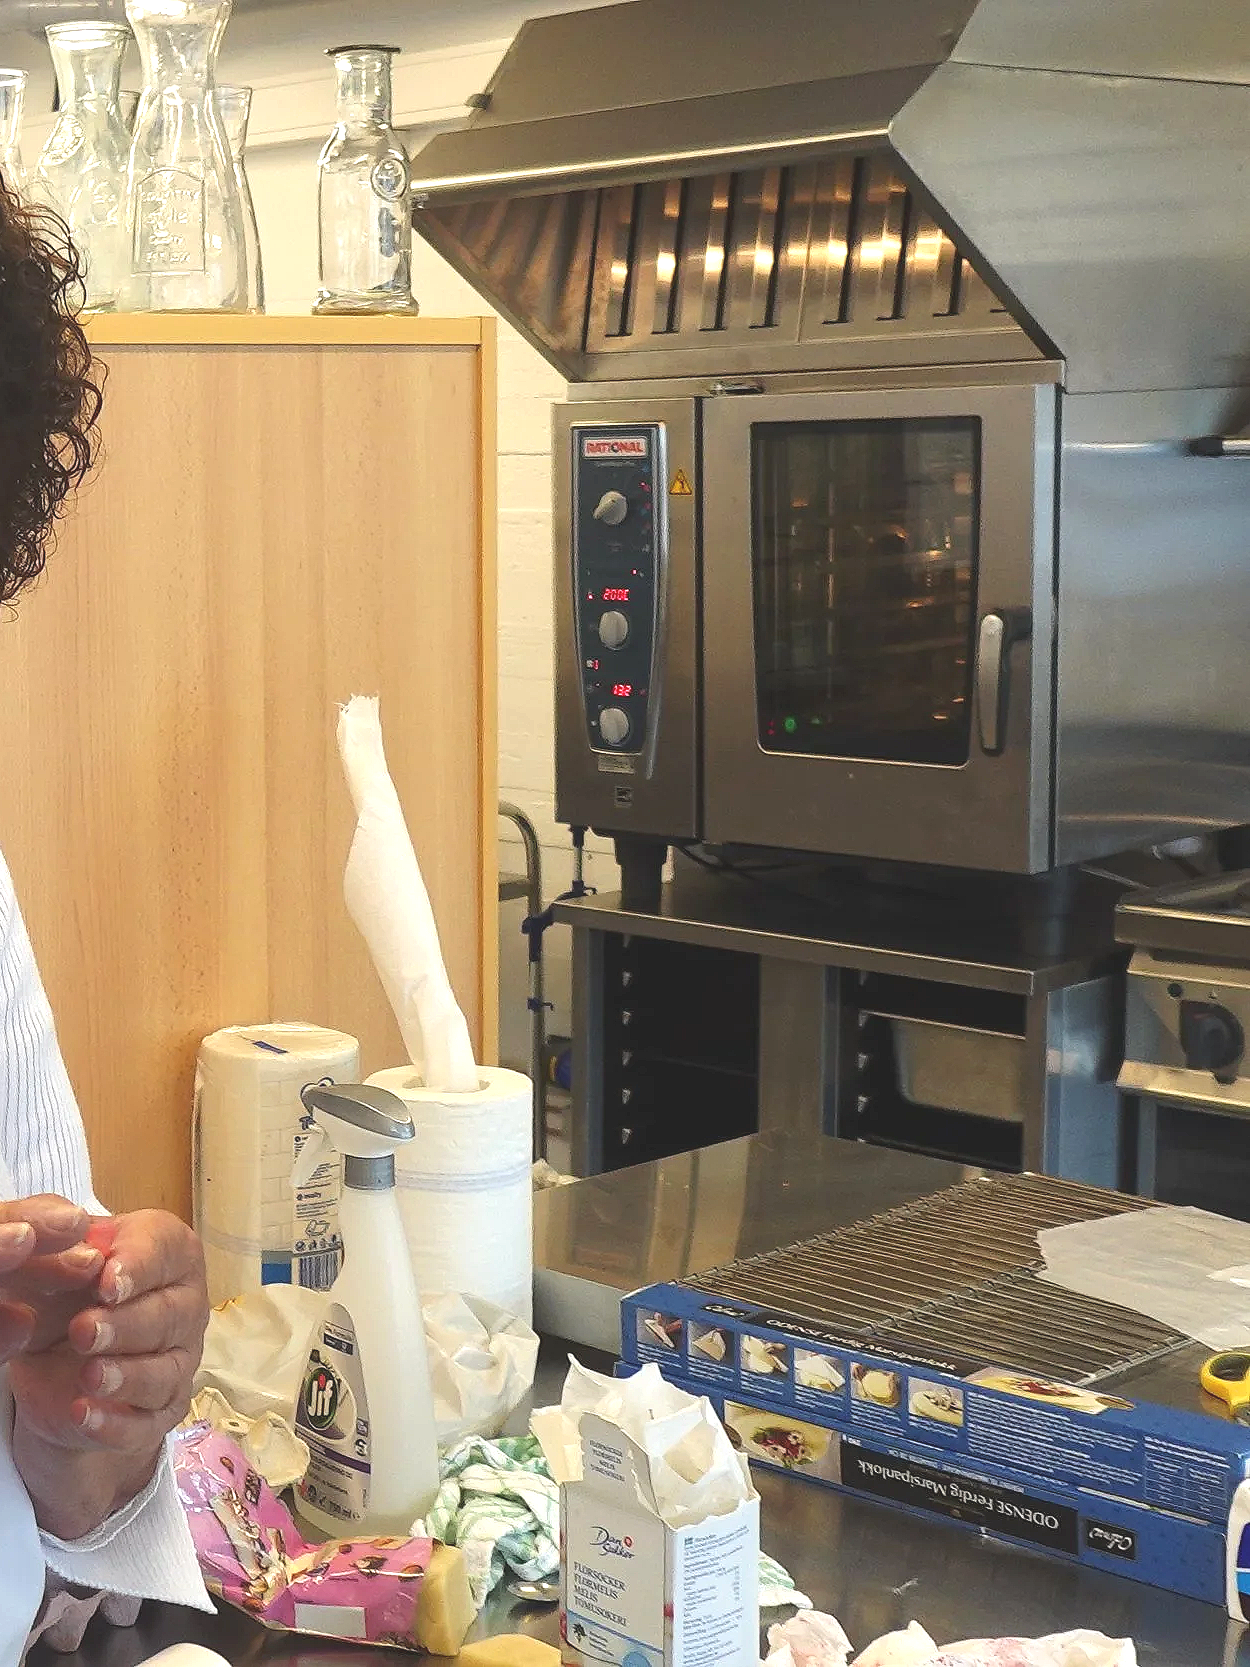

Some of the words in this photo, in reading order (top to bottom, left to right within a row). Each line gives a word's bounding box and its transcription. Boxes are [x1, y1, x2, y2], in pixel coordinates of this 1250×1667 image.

[586, 441, 644, 454] RATIONAL
[857, 1459, 947, 1496] Marsipanlokk
[950, 1482, 994, 1511] Ferdig
[998, 1500, 1060, 1530] ODENSE
